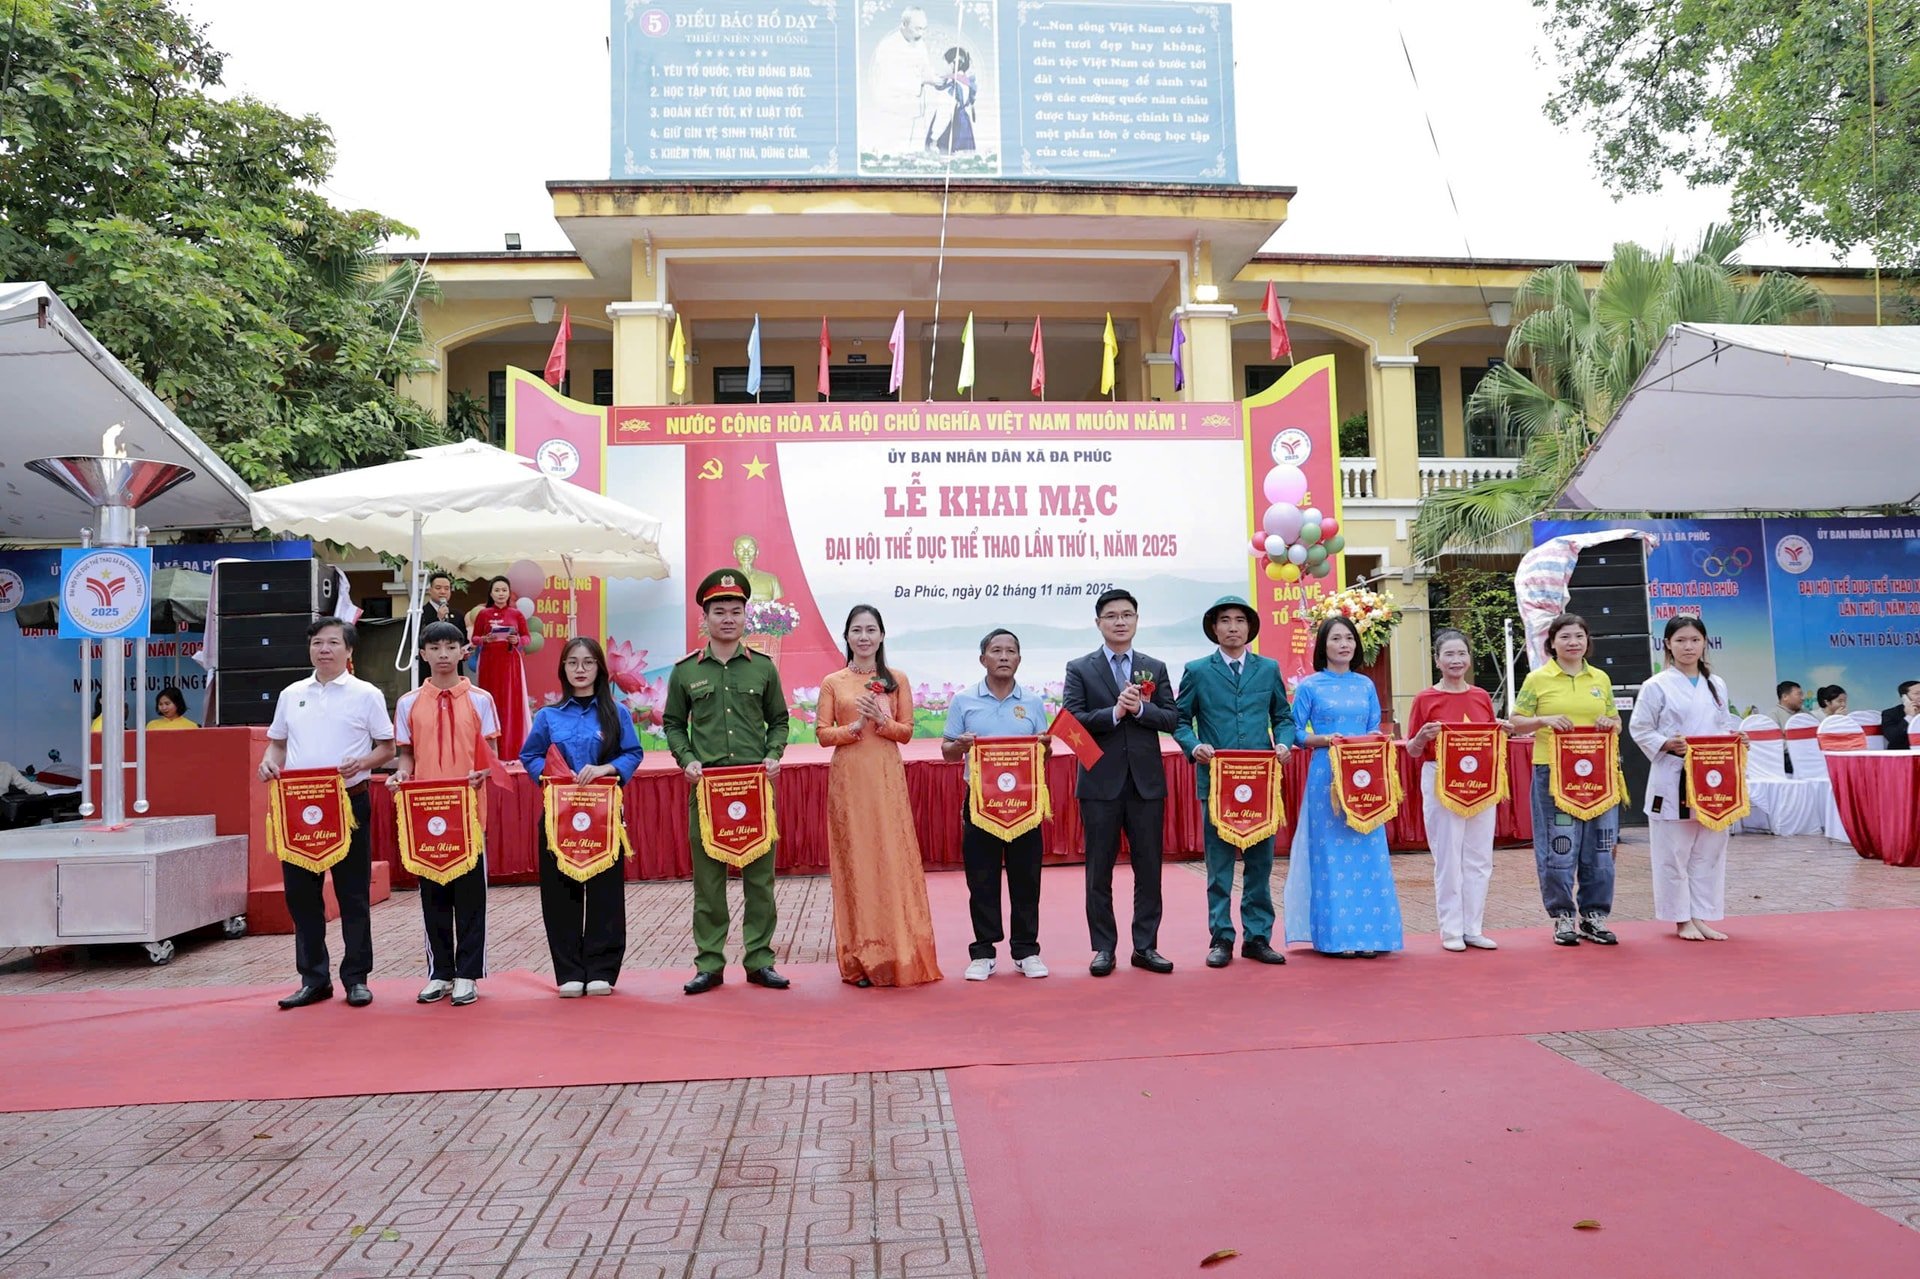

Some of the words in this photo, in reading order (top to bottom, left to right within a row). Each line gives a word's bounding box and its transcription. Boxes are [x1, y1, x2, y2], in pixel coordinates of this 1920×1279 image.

[648, 14, 662, 32] 5
[675, 8, 716, 28] ĐIỀU
[720, 10, 753, 29] BÁC
[757, 8, 781, 29] HỒ
[784, 14, 818, 31] DẠY
[666, 413, 717, 435] NƯỚC
[721, 412, 772, 438] CỘNG
[777, 411, 814, 433] HÒA
[819, 411, 844, 432] XÃ
[849, 411, 878, 435] HỘI
[884, 408, 920, 432] CHỦ
[925, 410, 981, 431] NGHĨA
[986, 410, 1024, 434] VIỆT
[1028, 413, 1071, 431] NAM
[1076, 410, 1129, 431] MUÔN
[1133, 410, 1175, 431] NĂM
[1180, 413, 1187, 431] !
[888, 448, 906, 464] ỦY
[911, 451, 941, 463] BAN
[946, 448, 987, 463] NHÂN
[991, 448, 1022, 463] DÂN
[1026, 449, 1046, 463] XÃ
[1050, 451, 1069, 463] ĐA
[1074, 449, 1112, 462] PHÚC
[884, 471, 927, 518] LỄ
[939, 485, 1028, 516] KHAI
[1039, 484, 1118, 523] MẠC
[1817, 527, 1829, 539] ỦY
[1830, 529, 1847, 539] BAN
[1848, 528, 1871, 539] NHÂN
[1873, 528, 1890, 539] DÂN
[1891, 528, 1903, 539] XÃ
[1904, 529, 1916, 539] ĐA
[825, 537, 851, 565] ĐẠI
[855, 532, 881, 565] HỘI
[885, 527, 912, 559] THỂ
[916, 535, 947, 564] DỤC
[951, 526, 978, 559] THỂ
[982, 535, 1020, 558] THAO
[1025, 527, 1053, 558] LẦN
[1058, 530, 1087, 557] THỨ
[1090, 534, 1099, 560] I,
[1104, 529, 1138, 557] NĂM
[1142, 534, 1177, 557] 2025
[894, 585, 911, 598] Đa
[914, 584, 948, 599] Phúc,
[952, 585, 982, 600] ngày
[985, 584, 999, 597] 02
[1002, 584, 1037, 599] tháng
[1040, 584, 1053, 596] 11
[1056, 583, 1082, 596] năm
[1086, 583, 1114, 596] 2025
[1660, 582, 1683, 597] THAO
[1685, 580, 1697, 596] XÃ
[1699, 582, 1712, 596] ĐA
[1713, 579, 1739, 596] PHÚC
[1799, 580, 1814, 597] ĐẠI
[1815, 577, 1832, 597] HỘI
[1833, 575, 1850, 594] THỂ
[1852, 580, 1870, 597] DỤC
[1871, 574, 1888, 594] THỂ
[1890, 579, 1913, 593] THAO
[91, 607, 119, 616] 2025
[537, 596, 560, 614] BÁC
[1839, 598, 1857, 616] LẦN
[1858, 599, 1877, 616] THỨ
[1878, 601, 1885, 617] I,
[1885, 599, 1906, 616] NĂM
[1272, 605, 1289, 625] TỔ
[1830, 629, 1856, 647] MÔN
[1857, 633, 1876, 646] THI
[1878, 627, 1904, 646] ĐẤU:
[147, 640, 176, 657] NĂM
